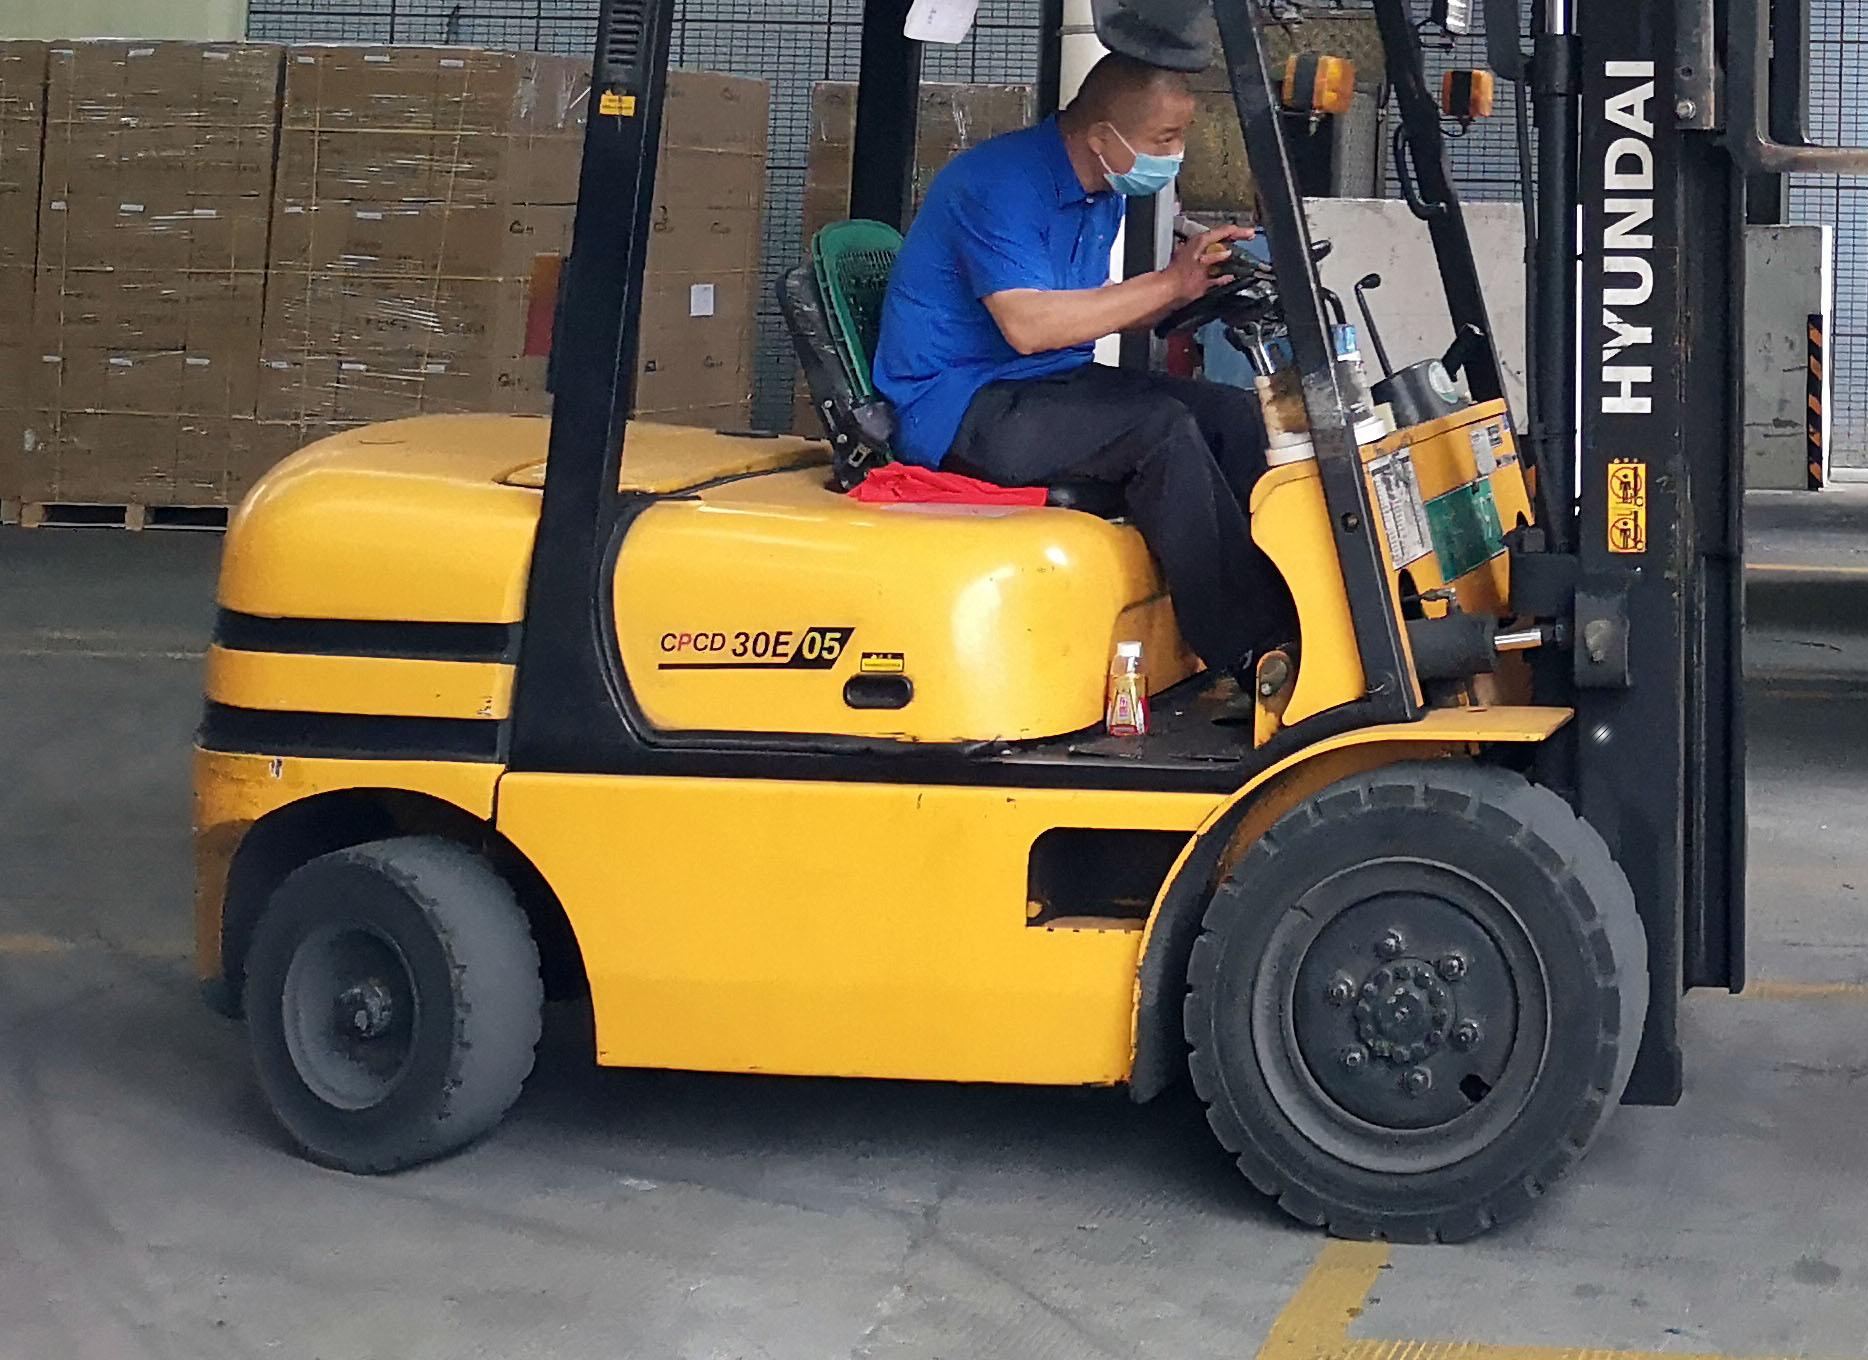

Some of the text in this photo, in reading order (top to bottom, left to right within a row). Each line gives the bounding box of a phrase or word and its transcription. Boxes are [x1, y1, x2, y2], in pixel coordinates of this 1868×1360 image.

[1601, 60, 1655, 415] HYUNDAI
[660, 631, 842, 660] CPCD 30E 05
